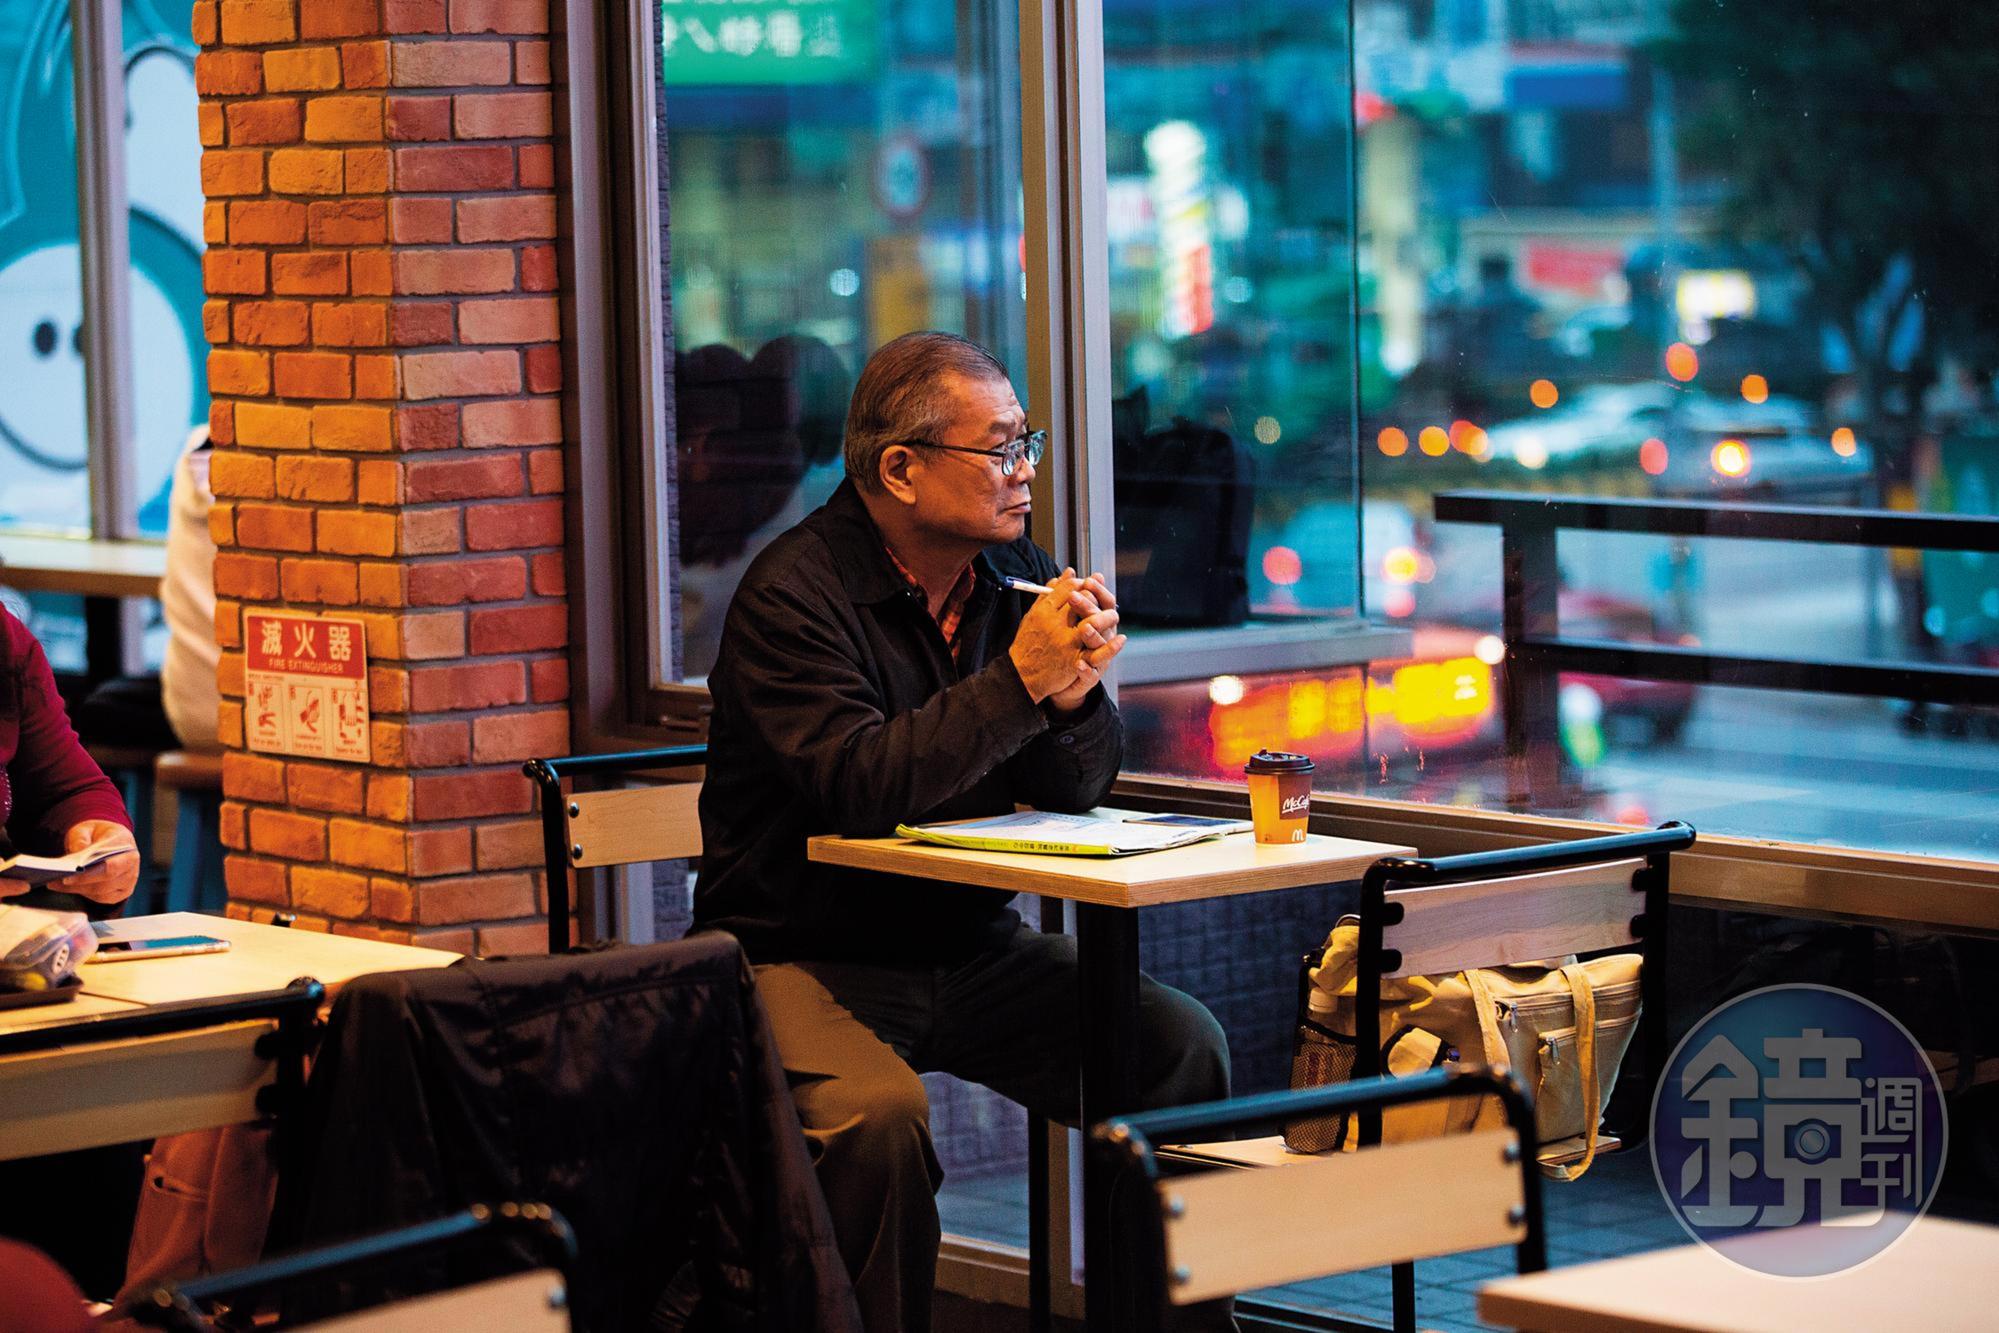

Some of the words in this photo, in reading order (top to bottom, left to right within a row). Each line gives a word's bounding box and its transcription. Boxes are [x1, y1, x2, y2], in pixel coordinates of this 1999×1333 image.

[262, 620, 352, 662] 滅火器
[268, 658, 286, 670] FIRE
[288, 660, 344, 674] EXTINGUISHER
